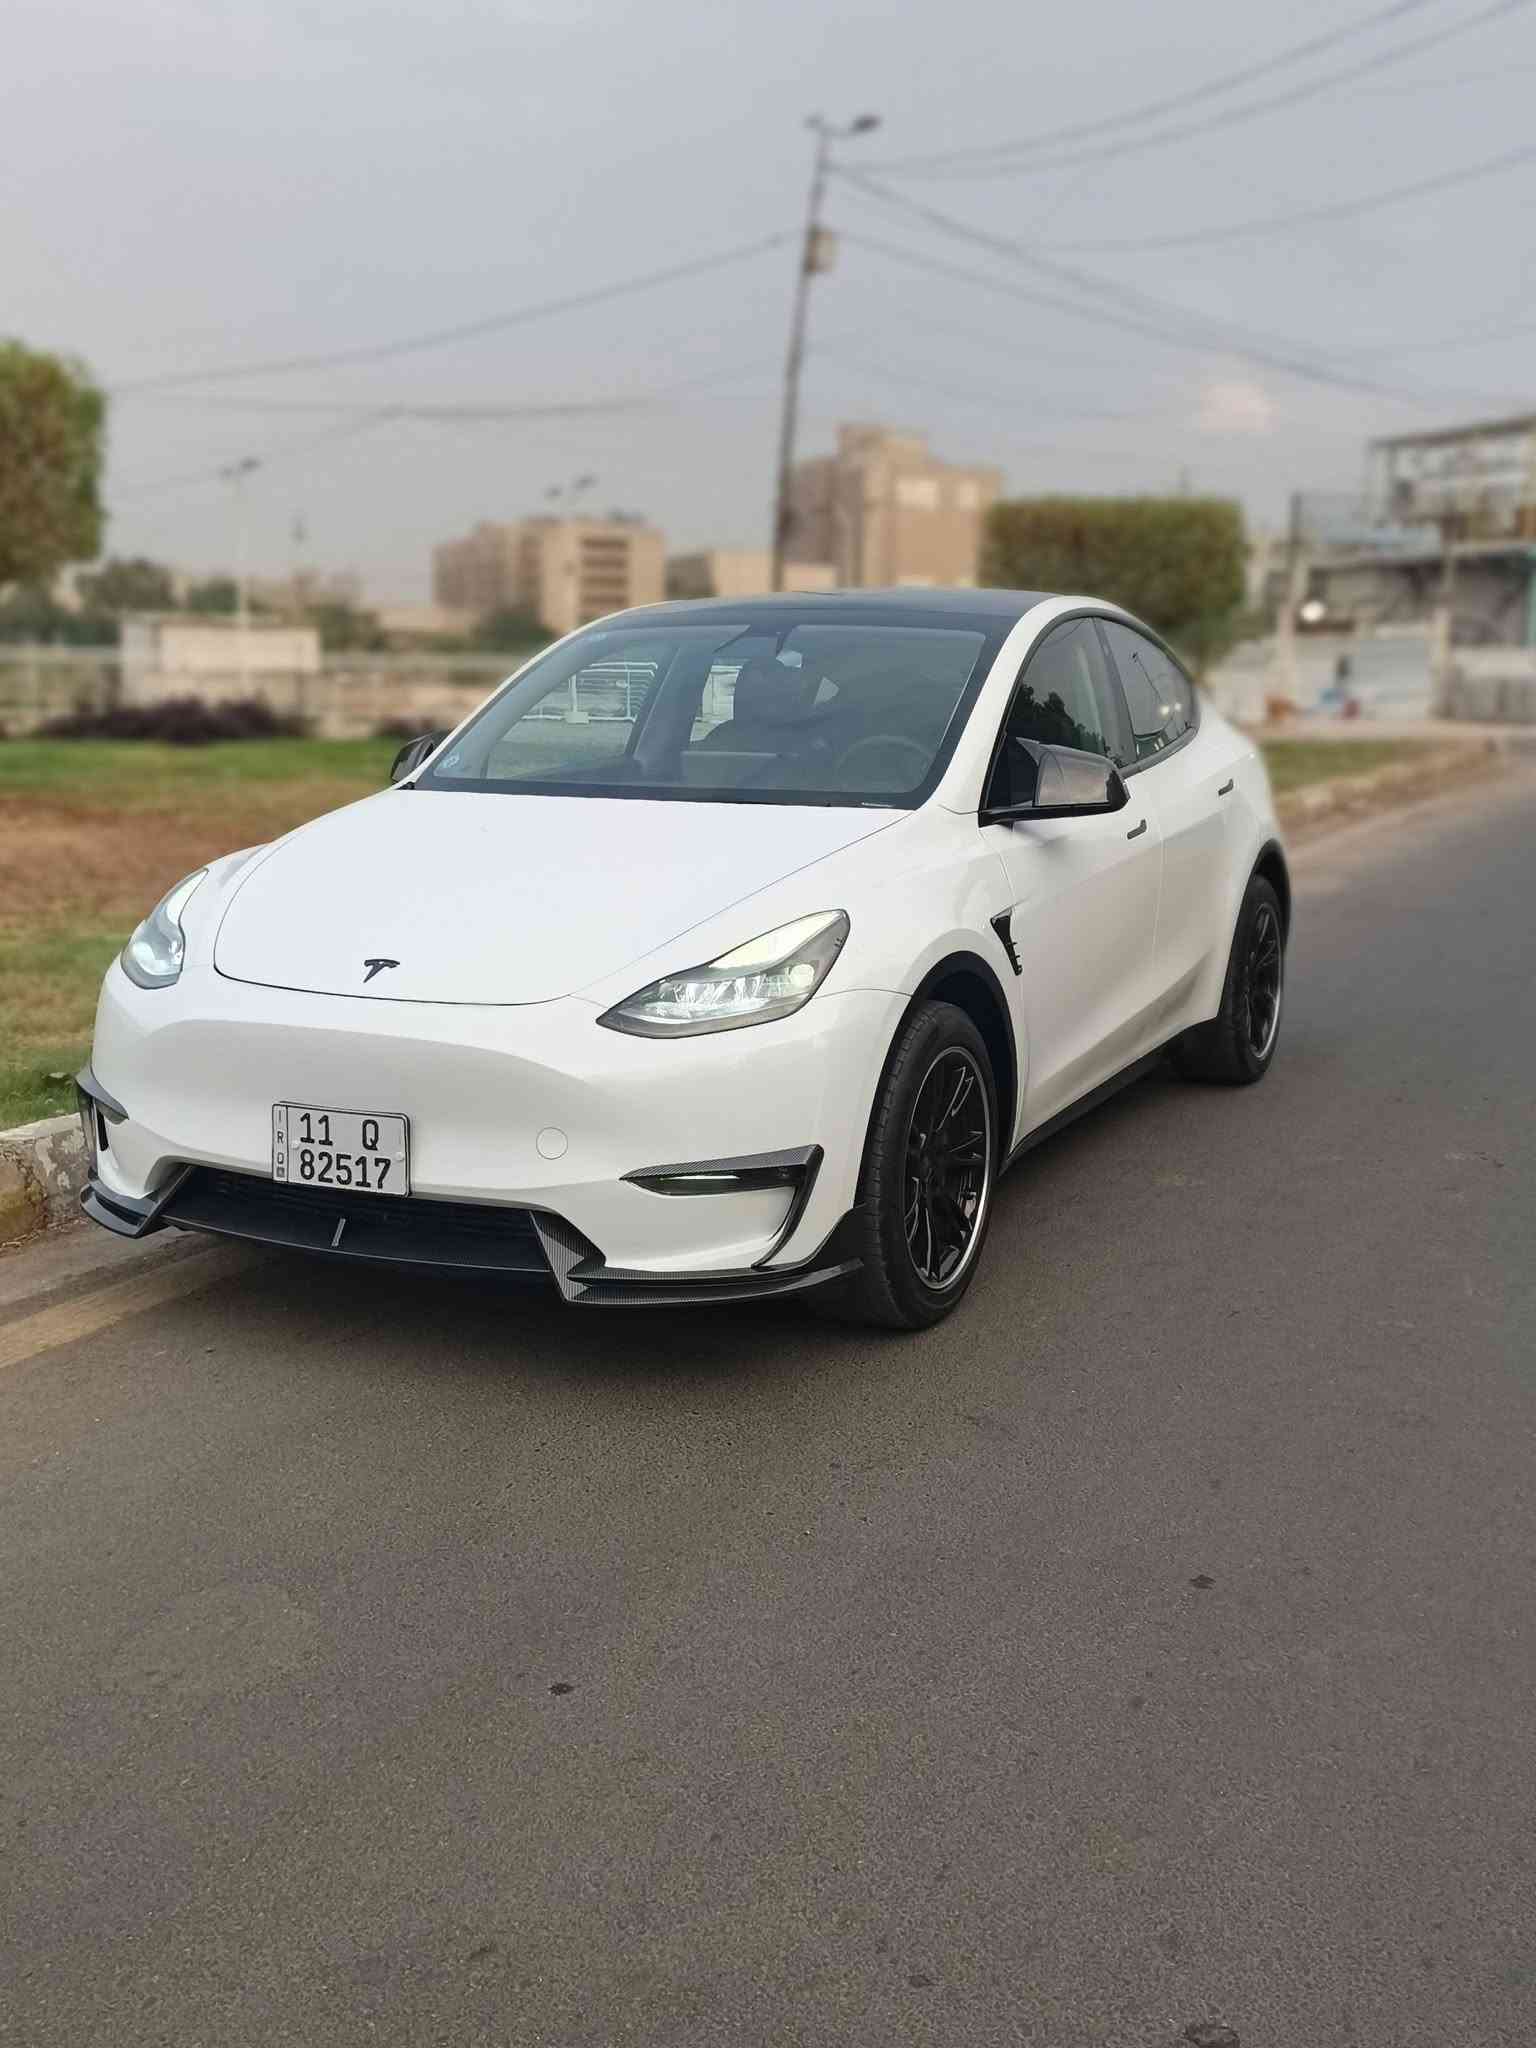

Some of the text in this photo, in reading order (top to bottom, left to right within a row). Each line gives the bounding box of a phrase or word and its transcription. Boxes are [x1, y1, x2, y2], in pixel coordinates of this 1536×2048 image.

[300, 1112, 380, 1151] 11 Q
[300, 1149, 391, 1189] 82517
